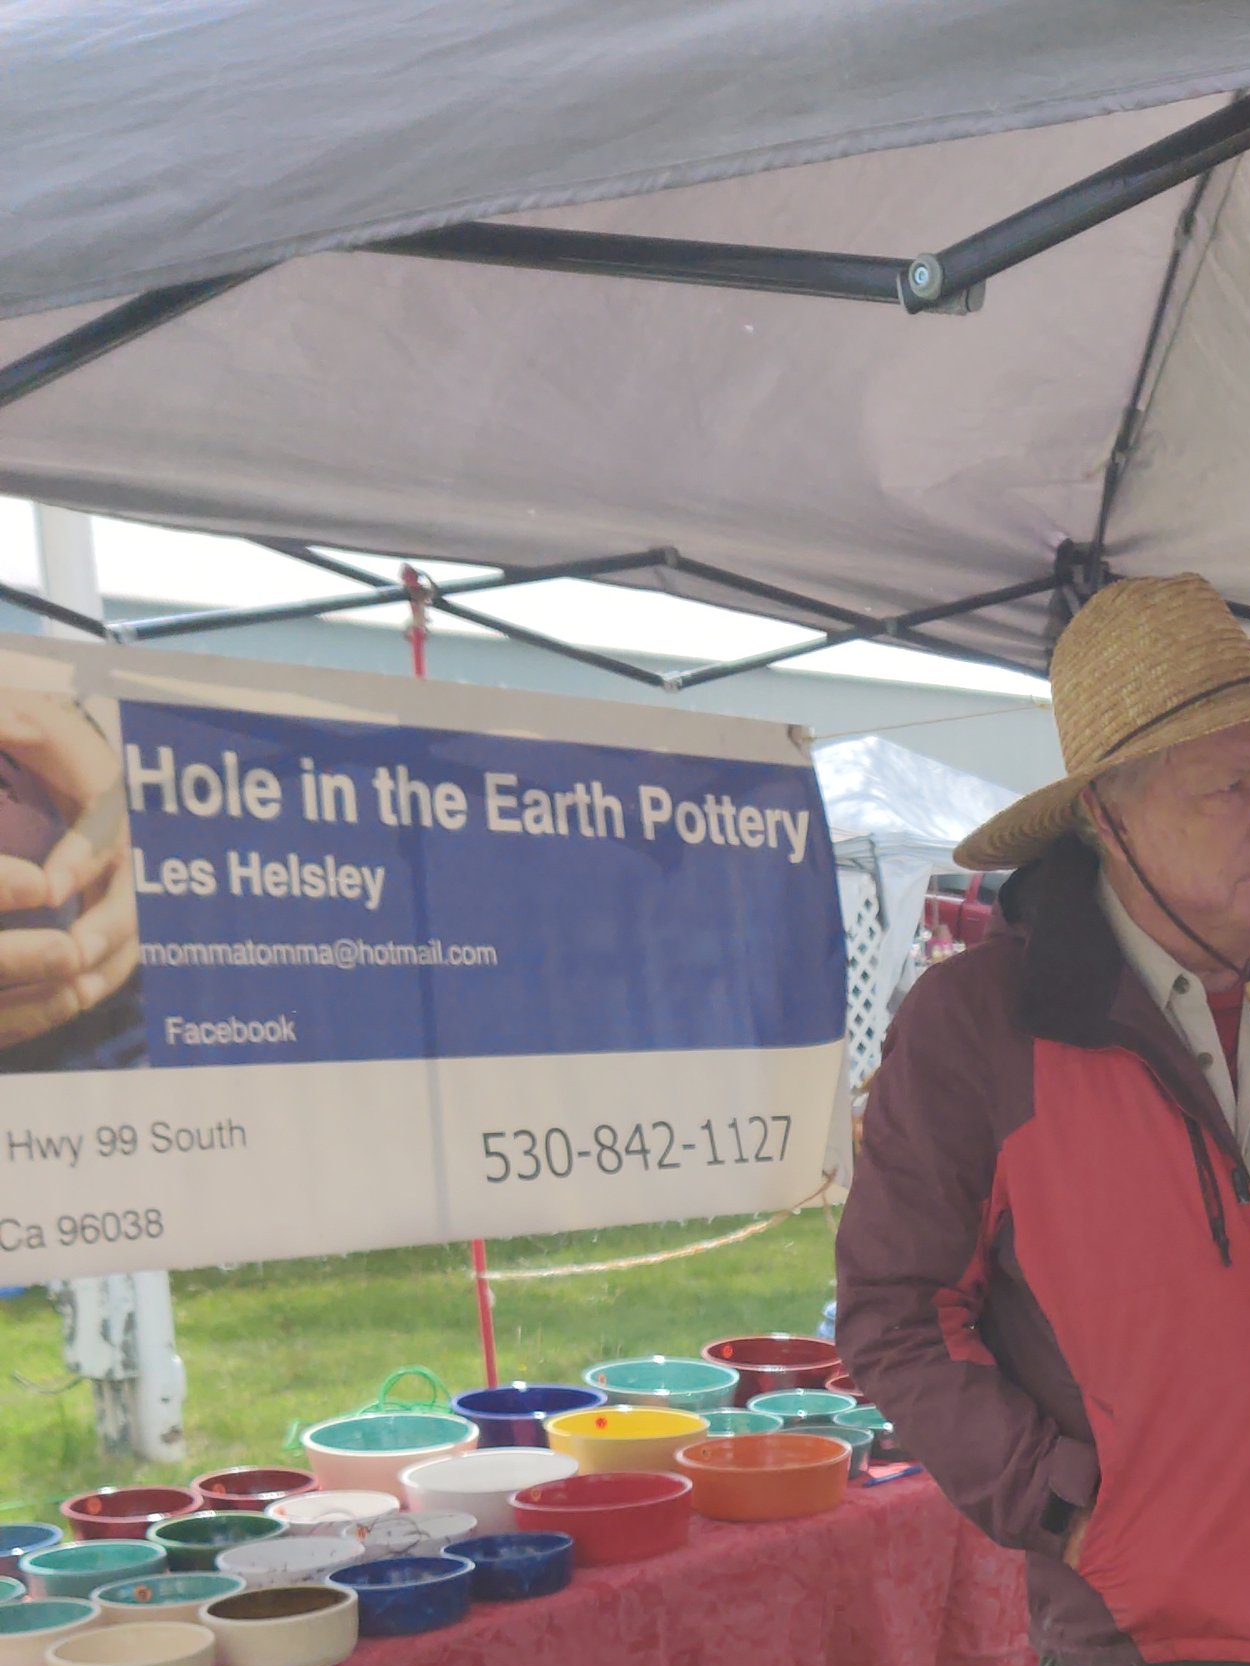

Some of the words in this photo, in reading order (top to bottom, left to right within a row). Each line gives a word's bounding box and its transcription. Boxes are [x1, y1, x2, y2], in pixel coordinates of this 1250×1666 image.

[126, 744, 282, 820] Hole
[301, 757, 358, 823] in
[373, 764, 467, 831] the
[484, 771, 626, 839] Earth
[639, 785, 809, 864] Pottery
[132, 847, 218, 895] Les
[227, 849, 385, 910] Helsley
[165, 1015, 297, 1046] Facebook
[7, 1129, 84, 1168] Hwy
[97, 1124, 138, 1157] 99
[151, 1118, 247, 1154] South
[482, 1115, 792, 1184] 530-842-1127
[0, 1218, 46, 1251] Ca
[57, 1208, 164, 1247] 96038
